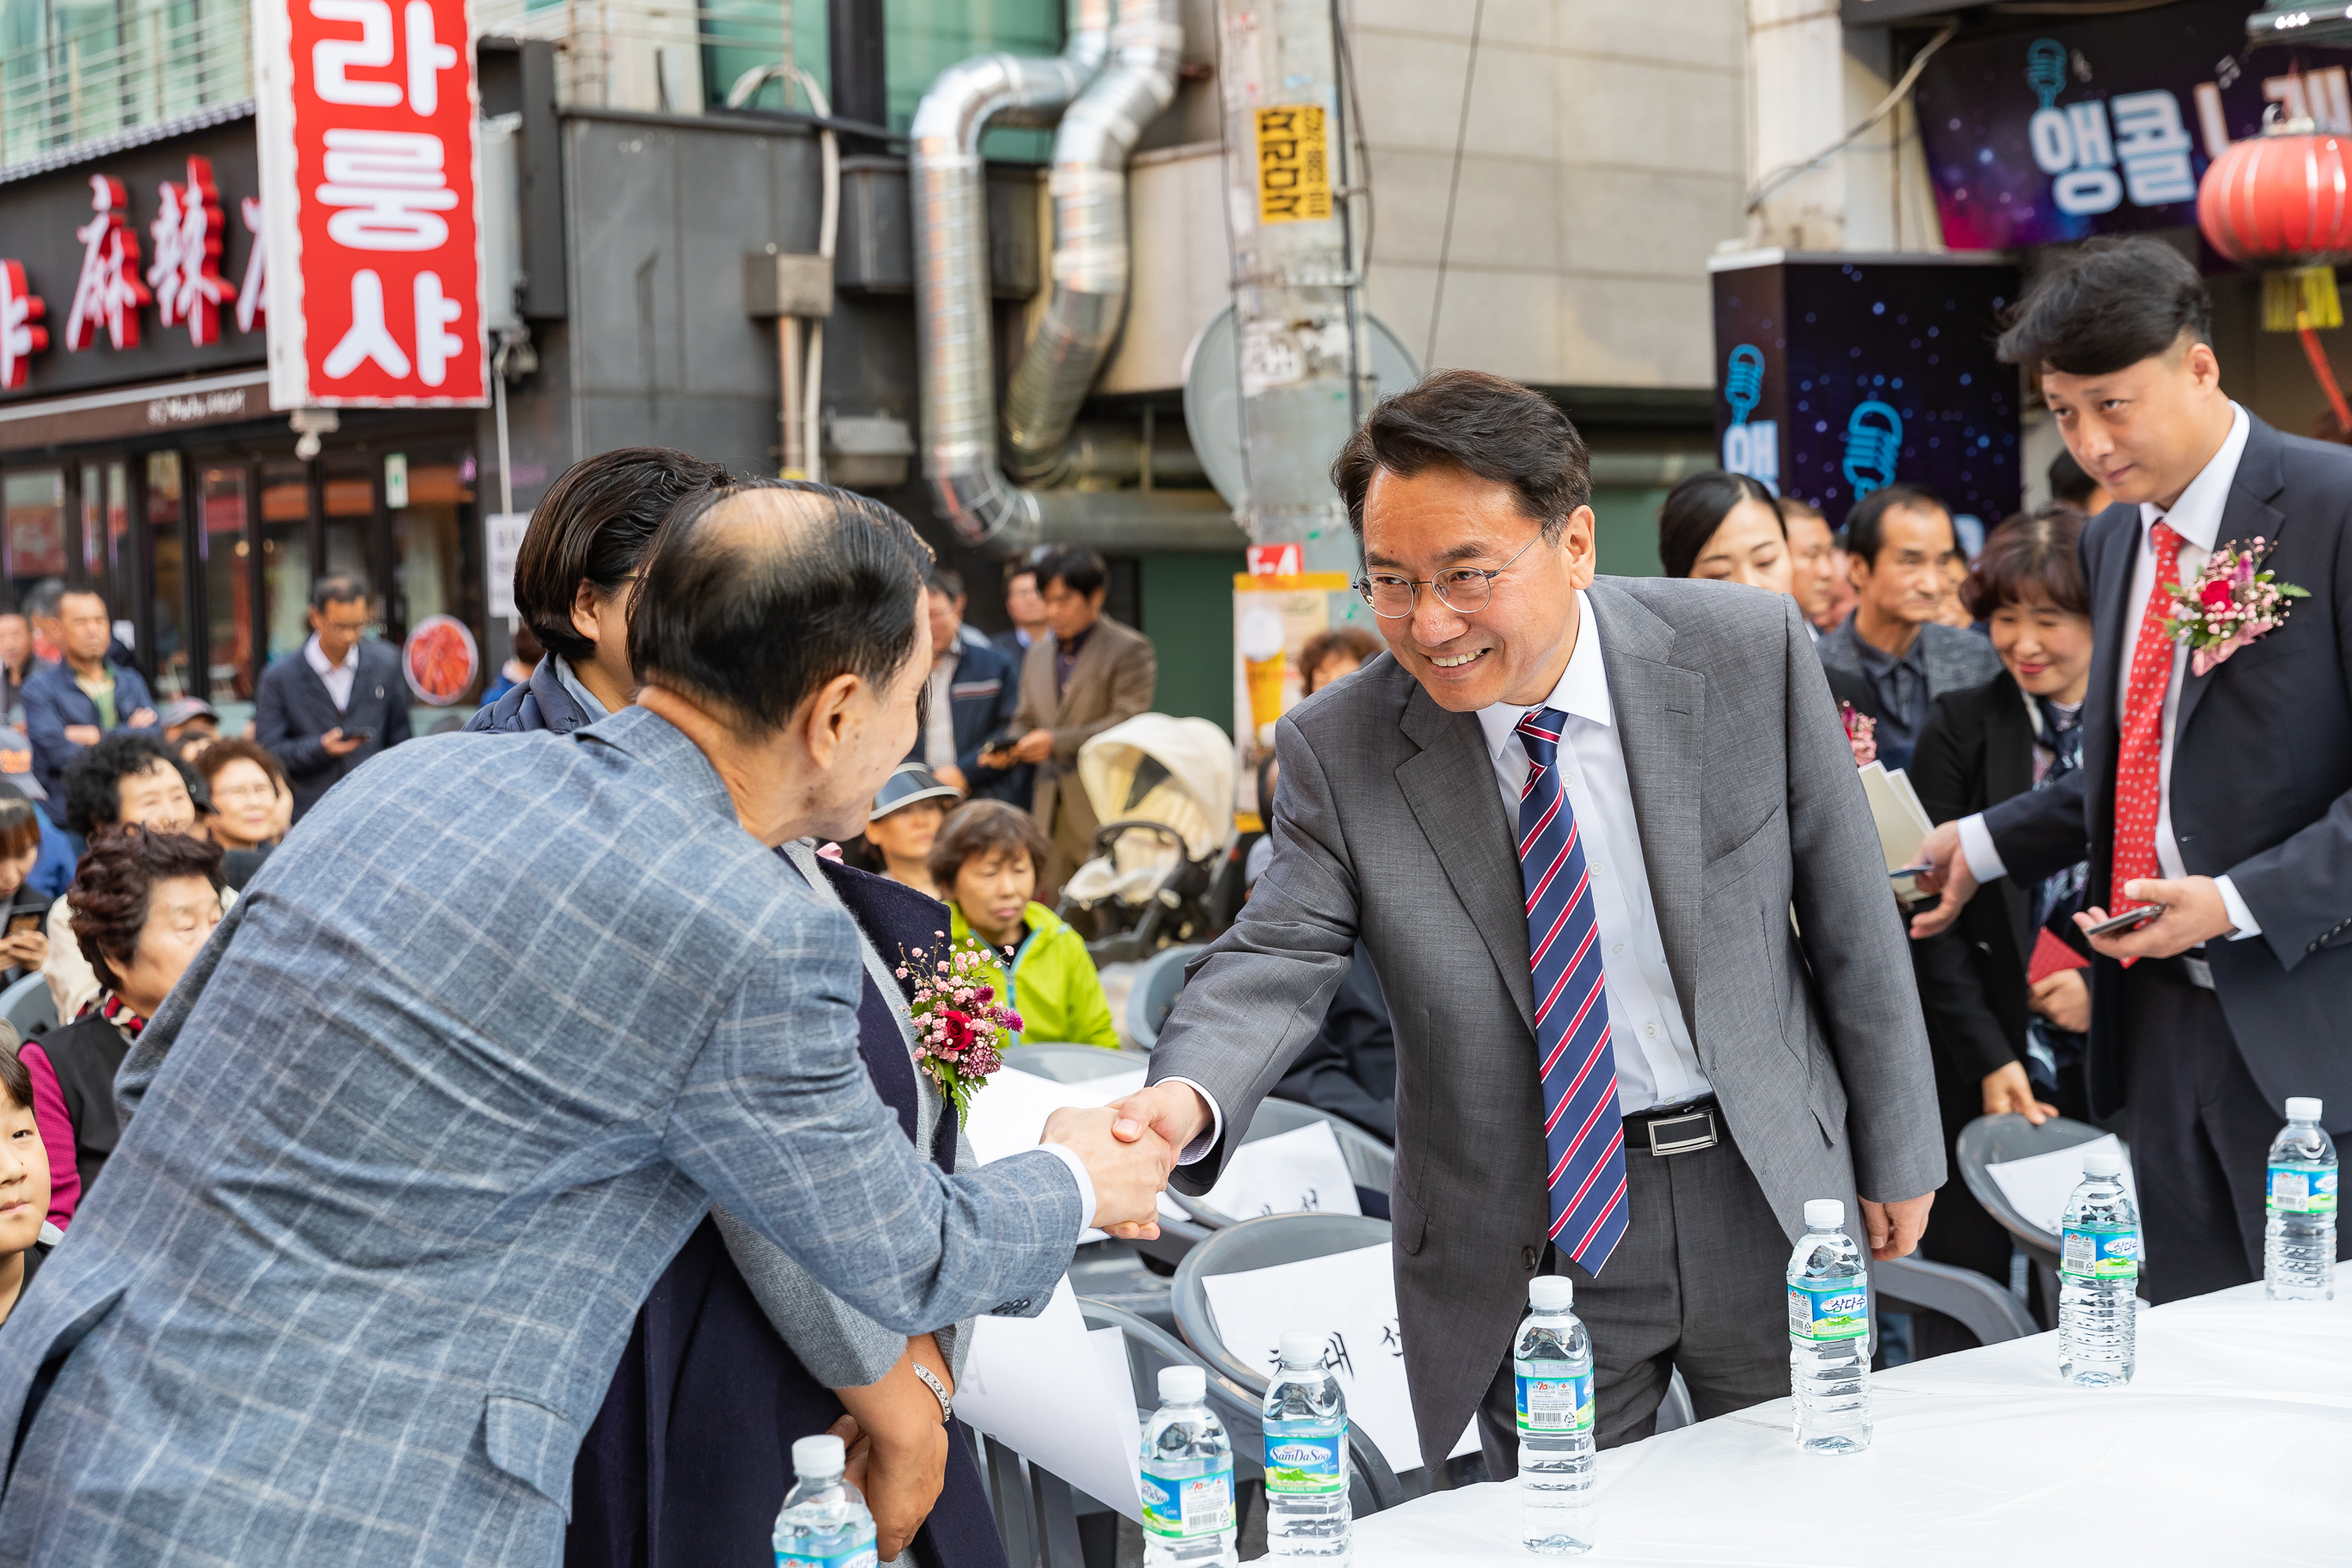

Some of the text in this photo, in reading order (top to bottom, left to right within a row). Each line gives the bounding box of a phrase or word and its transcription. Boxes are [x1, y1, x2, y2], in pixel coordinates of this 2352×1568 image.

[2029, 89, 2196, 217] 앵콜
[1824, 1295, 1865, 1314] 삼다수
[1272, 1448, 1329, 1462] SamDaSoo
